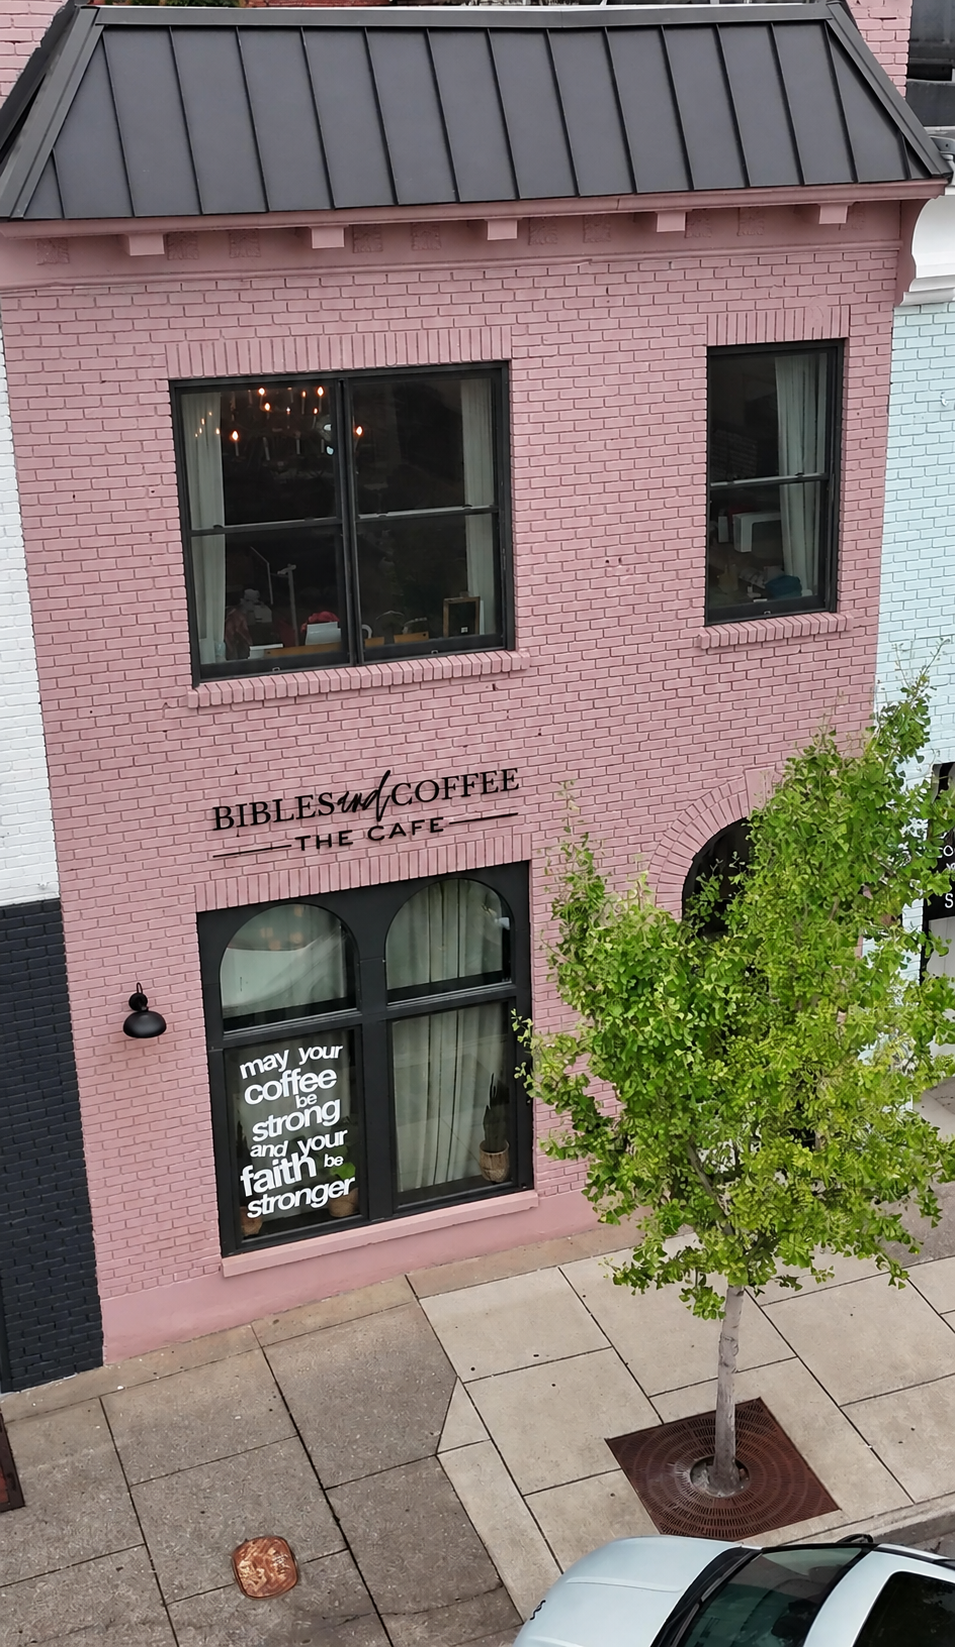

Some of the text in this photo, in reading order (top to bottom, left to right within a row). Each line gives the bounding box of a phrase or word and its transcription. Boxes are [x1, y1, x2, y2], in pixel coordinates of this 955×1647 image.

[212, 768, 519, 831] BIBLES and COFFEE
[295, 817, 444, 851] THE CAFE
[240, 1046, 343, 1079] may your
[244, 1069, 337, 1105] coffee
[296, 1093, 317, 1109] be
[252, 1099, 341, 1142] strong
[250, 1130, 348, 1158] and your
[240, 1152, 344, 1197] faith be
[247, 1177, 356, 1219] stronger
